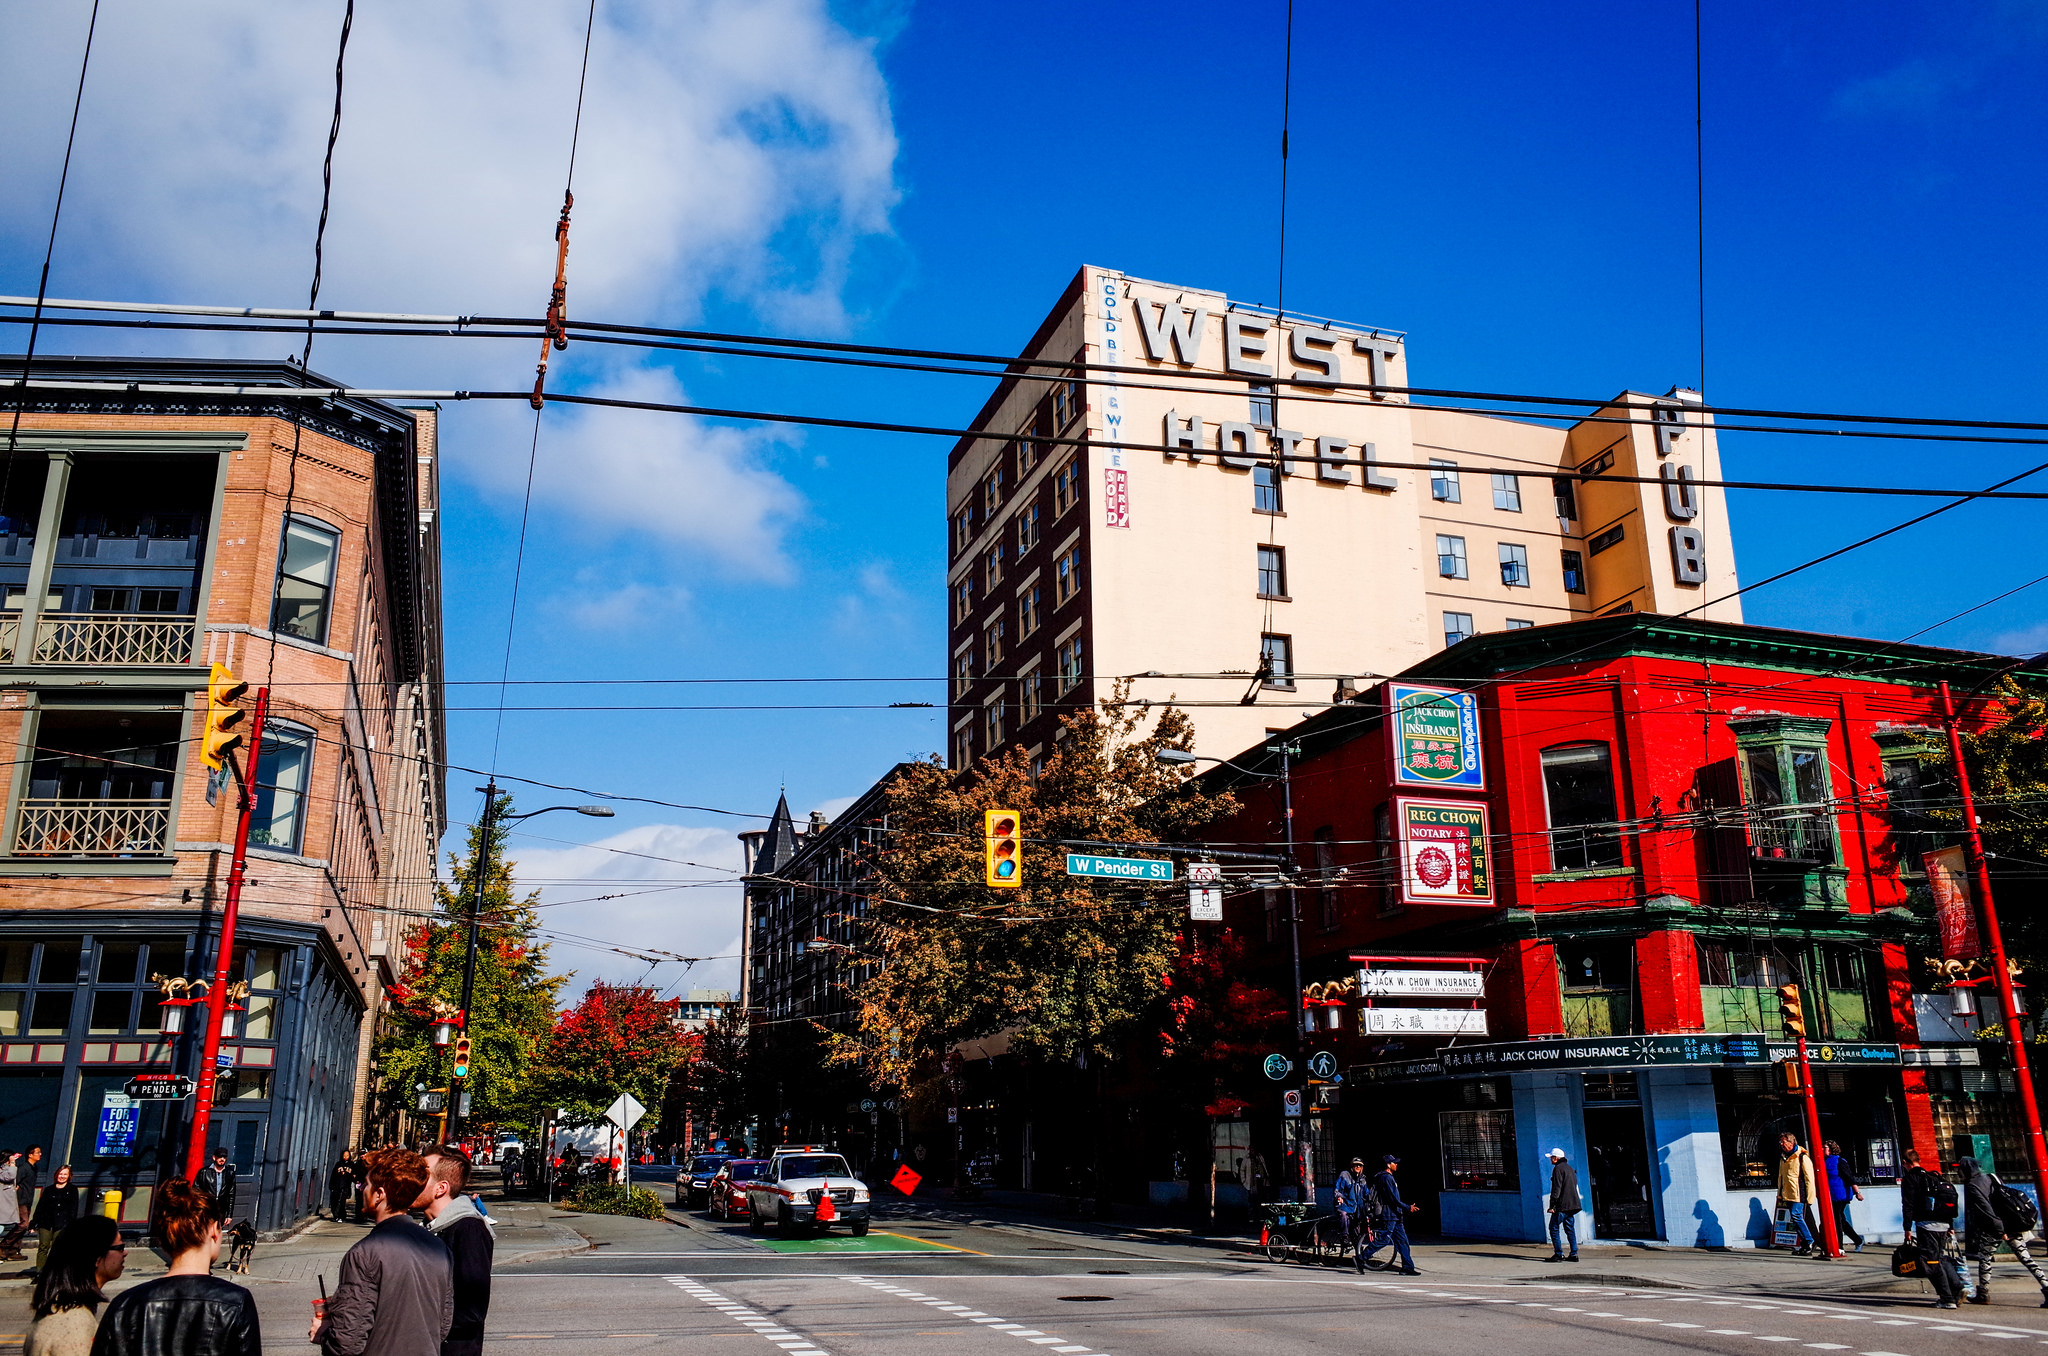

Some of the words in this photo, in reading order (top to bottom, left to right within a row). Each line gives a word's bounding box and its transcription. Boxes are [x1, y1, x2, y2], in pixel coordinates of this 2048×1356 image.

[1105, 285, 1116, 332] COLD
[1132, 296, 1398, 399] WEST
[1164, 410, 1398, 491] HOTEL
[1106, 471, 1118, 524] SOLD
[1117, 473, 1126, 513] HERE
[1652, 400, 1708, 585] PUB
[1413, 708, 1433, 717] JACK
[1433, 708, 1456, 718] CHOW
[1405, 723, 1458, 737] INSURANCE
[1410, 810, 1437, 822] REG
[1440, 811, 1480, 824] CHOW
[1411, 828, 1452, 838] NOTARY
[1076, 858, 1089, 872] W
[1095, 861, 1145, 876] Pender
[1150, 864, 1166, 878] St
[1374, 977, 1394, 986] JACK
[1397, 977, 1407, 986] W.
[1409, 977, 1430, 987] CHOW
[1435, 978, 1477, 988] INSURANCE
[1500, 1051, 1525, 1062] JACK
[1527, 1049, 1560, 1060] CHOW
[1565, 1046, 1630, 1059] INSURANCE
[131, 1086, 137, 1094] W
[141, 1085, 177, 1094] PENDER
[109, 1108, 130, 1120] FOR
[102, 1120, 134, 1132] LEASE
